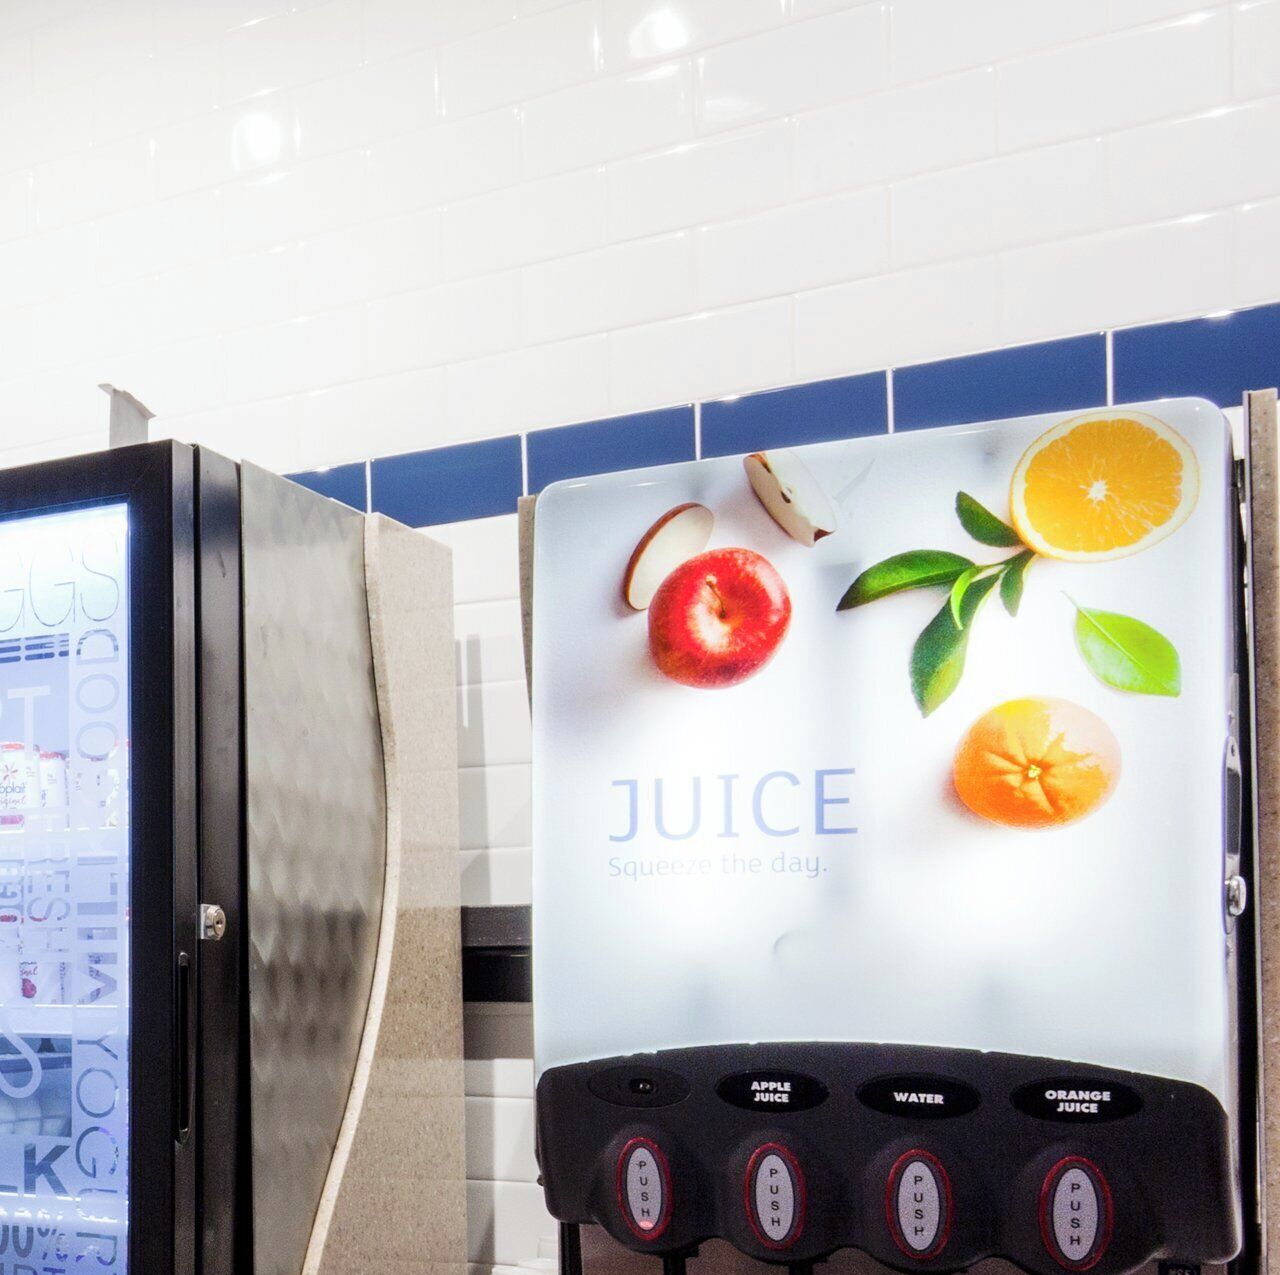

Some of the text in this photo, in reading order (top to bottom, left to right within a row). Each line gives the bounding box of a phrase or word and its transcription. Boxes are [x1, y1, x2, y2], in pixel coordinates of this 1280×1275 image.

[608, 767, 858, 842] JUICE
[608, 851, 828, 881] Squeeze the day.
[751, 1080, 792, 1093] APPLE
[753, 1092, 790, 1104] JUICE
[892, 1091, 945, 1105] WATER
[1044, 1089, 1112, 1103] ORANGE
[1056, 1101, 1099, 1114] JUICE
[637, 1159, 652, 1218] PUSH
[769, 1168, 781, 1228] PUSH
[913, 1175, 926, 1237] PUSH
[1070, 1182, 1082, 1247] PUSH
